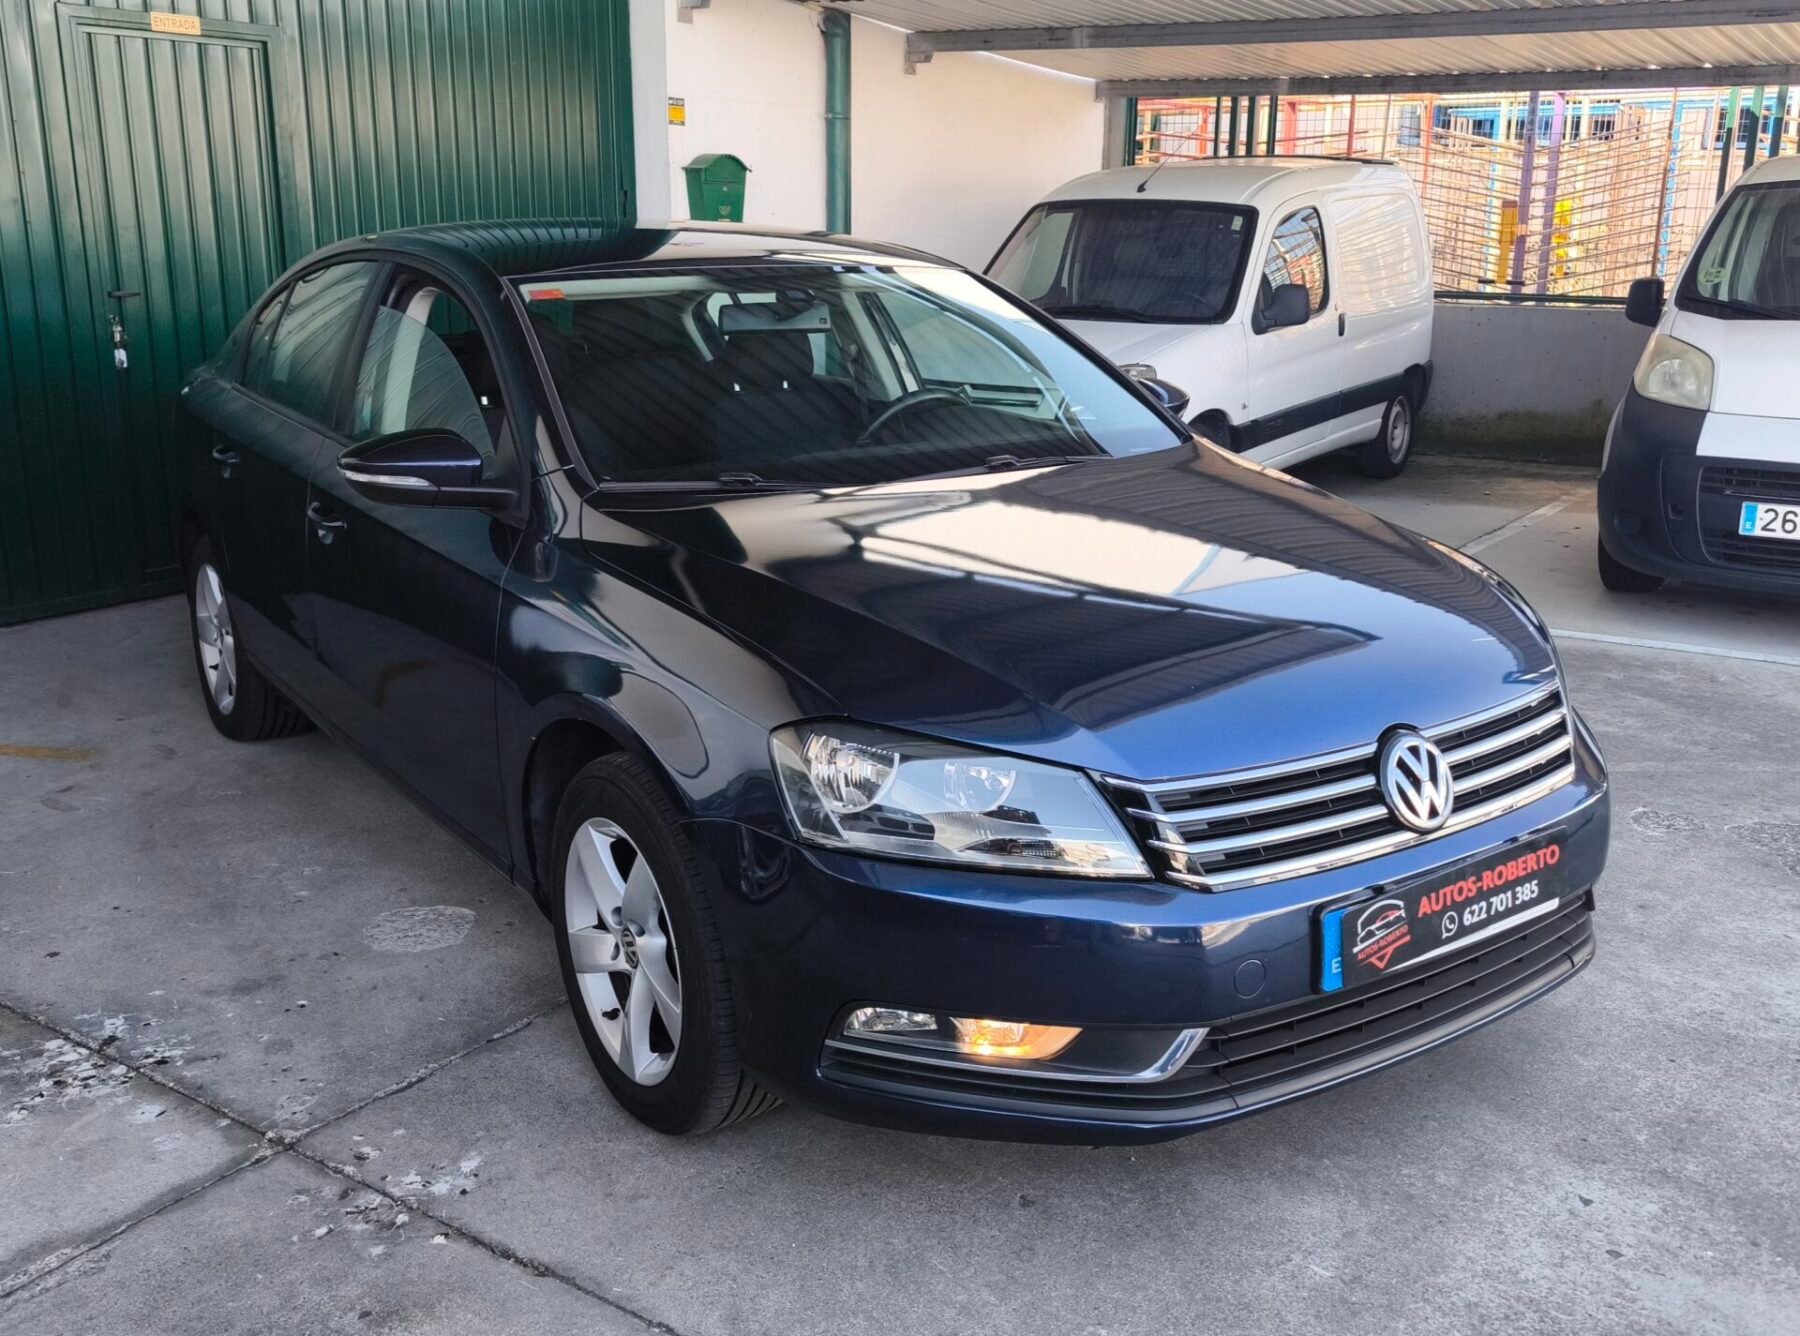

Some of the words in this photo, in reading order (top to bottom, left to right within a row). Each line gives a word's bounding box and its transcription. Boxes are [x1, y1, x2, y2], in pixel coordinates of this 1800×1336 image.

[153, 16, 196, 29] ENTRADA
[1418, 844, 1560, 917] AUTOS-ROBERTO
[1463, 901, 1488, 926] 622
[1489, 890, 1512, 915] 701
[1515, 880, 1539, 904] 385
